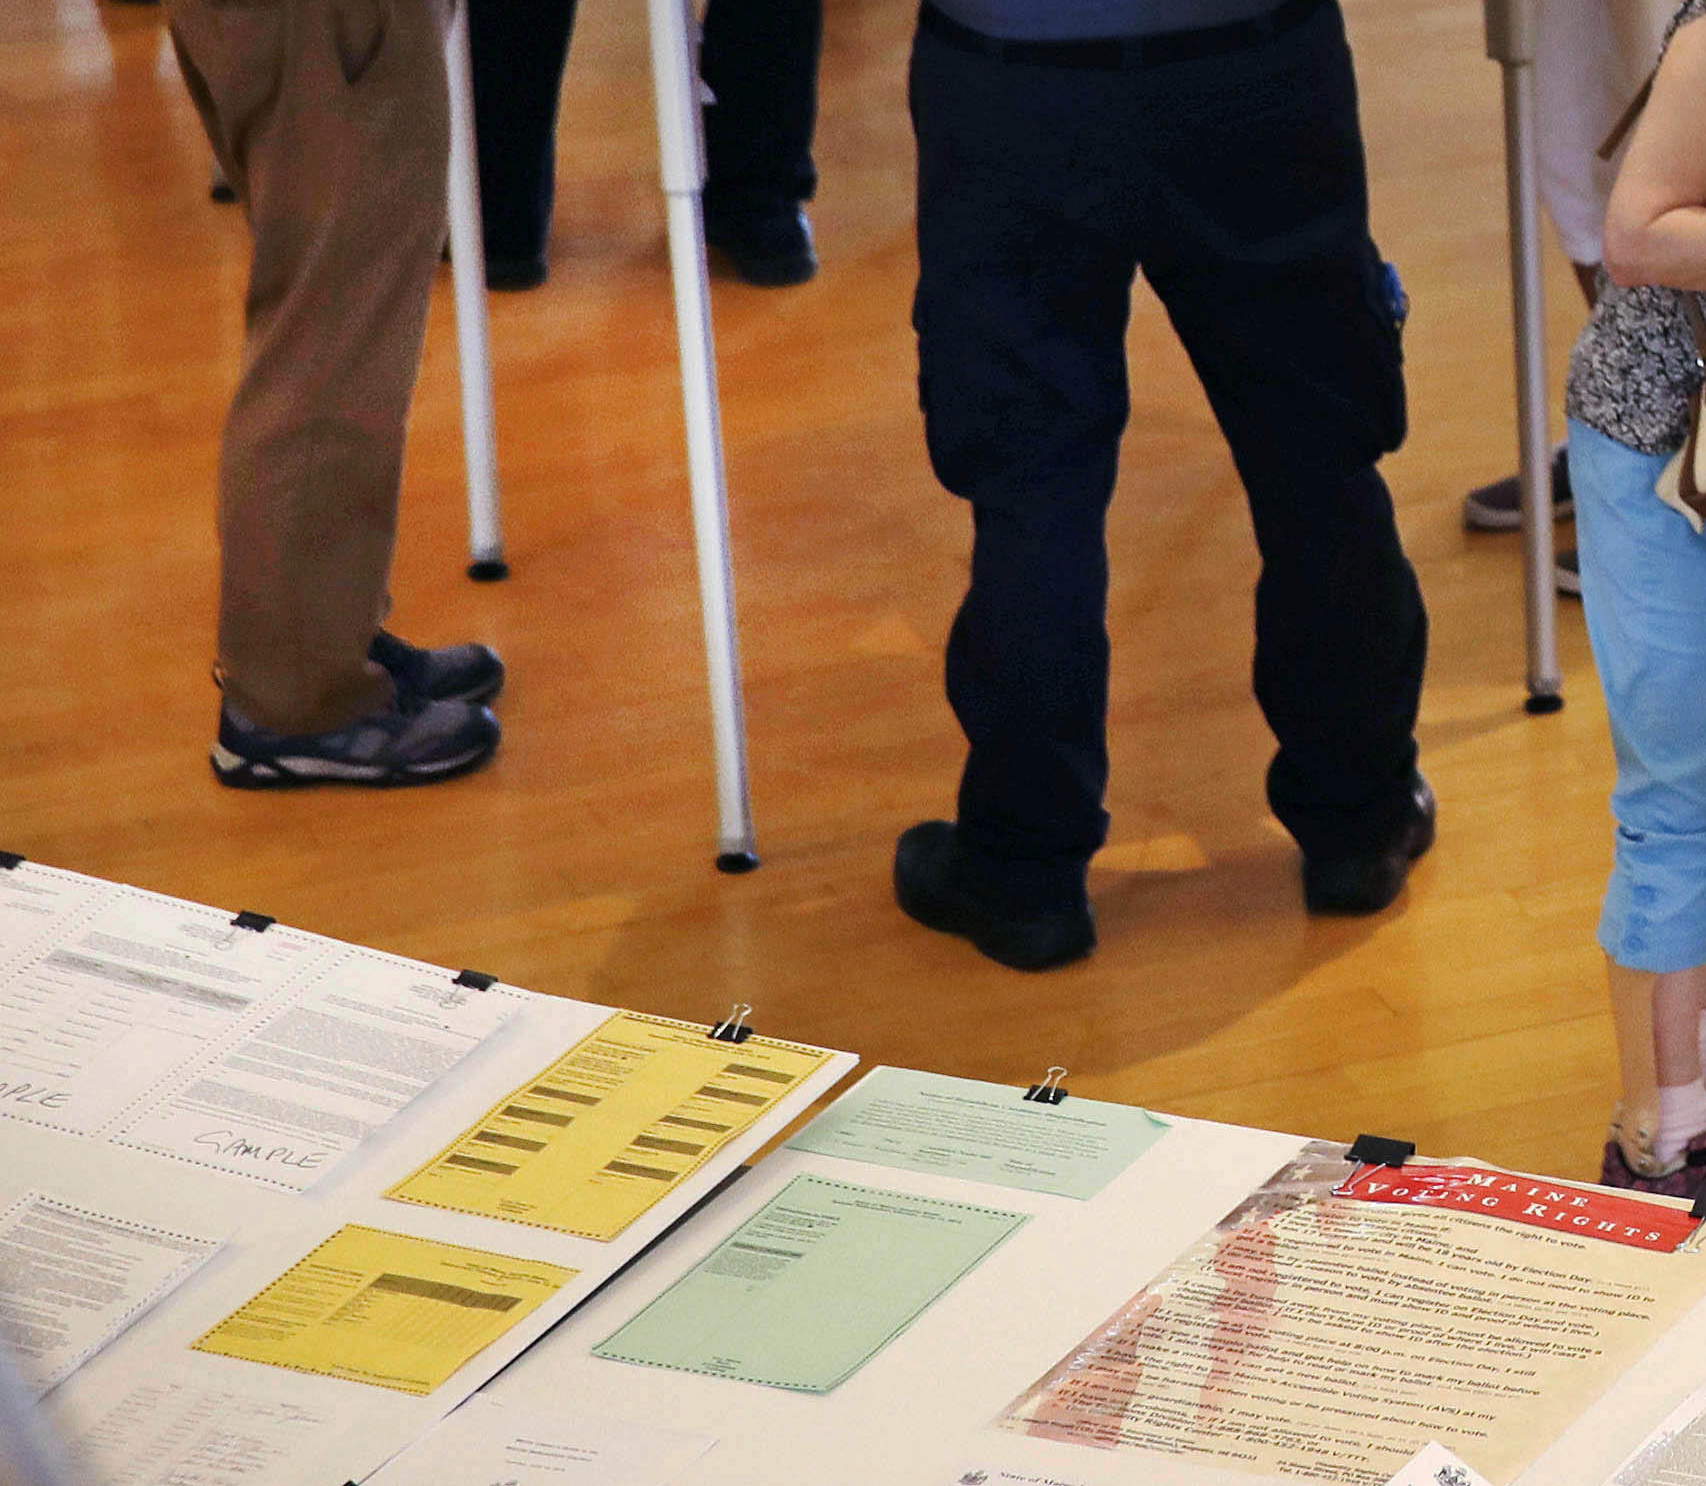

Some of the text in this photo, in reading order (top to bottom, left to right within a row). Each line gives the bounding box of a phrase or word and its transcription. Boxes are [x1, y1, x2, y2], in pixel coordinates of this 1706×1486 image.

[0, 1083, 72, 1108] PLE
[193, 1130, 329, 1170] SAMPLE
[1466, 1173, 1590, 1208] MAINE
[1365, 1182, 1663, 1242] VOTING RIGHTS
